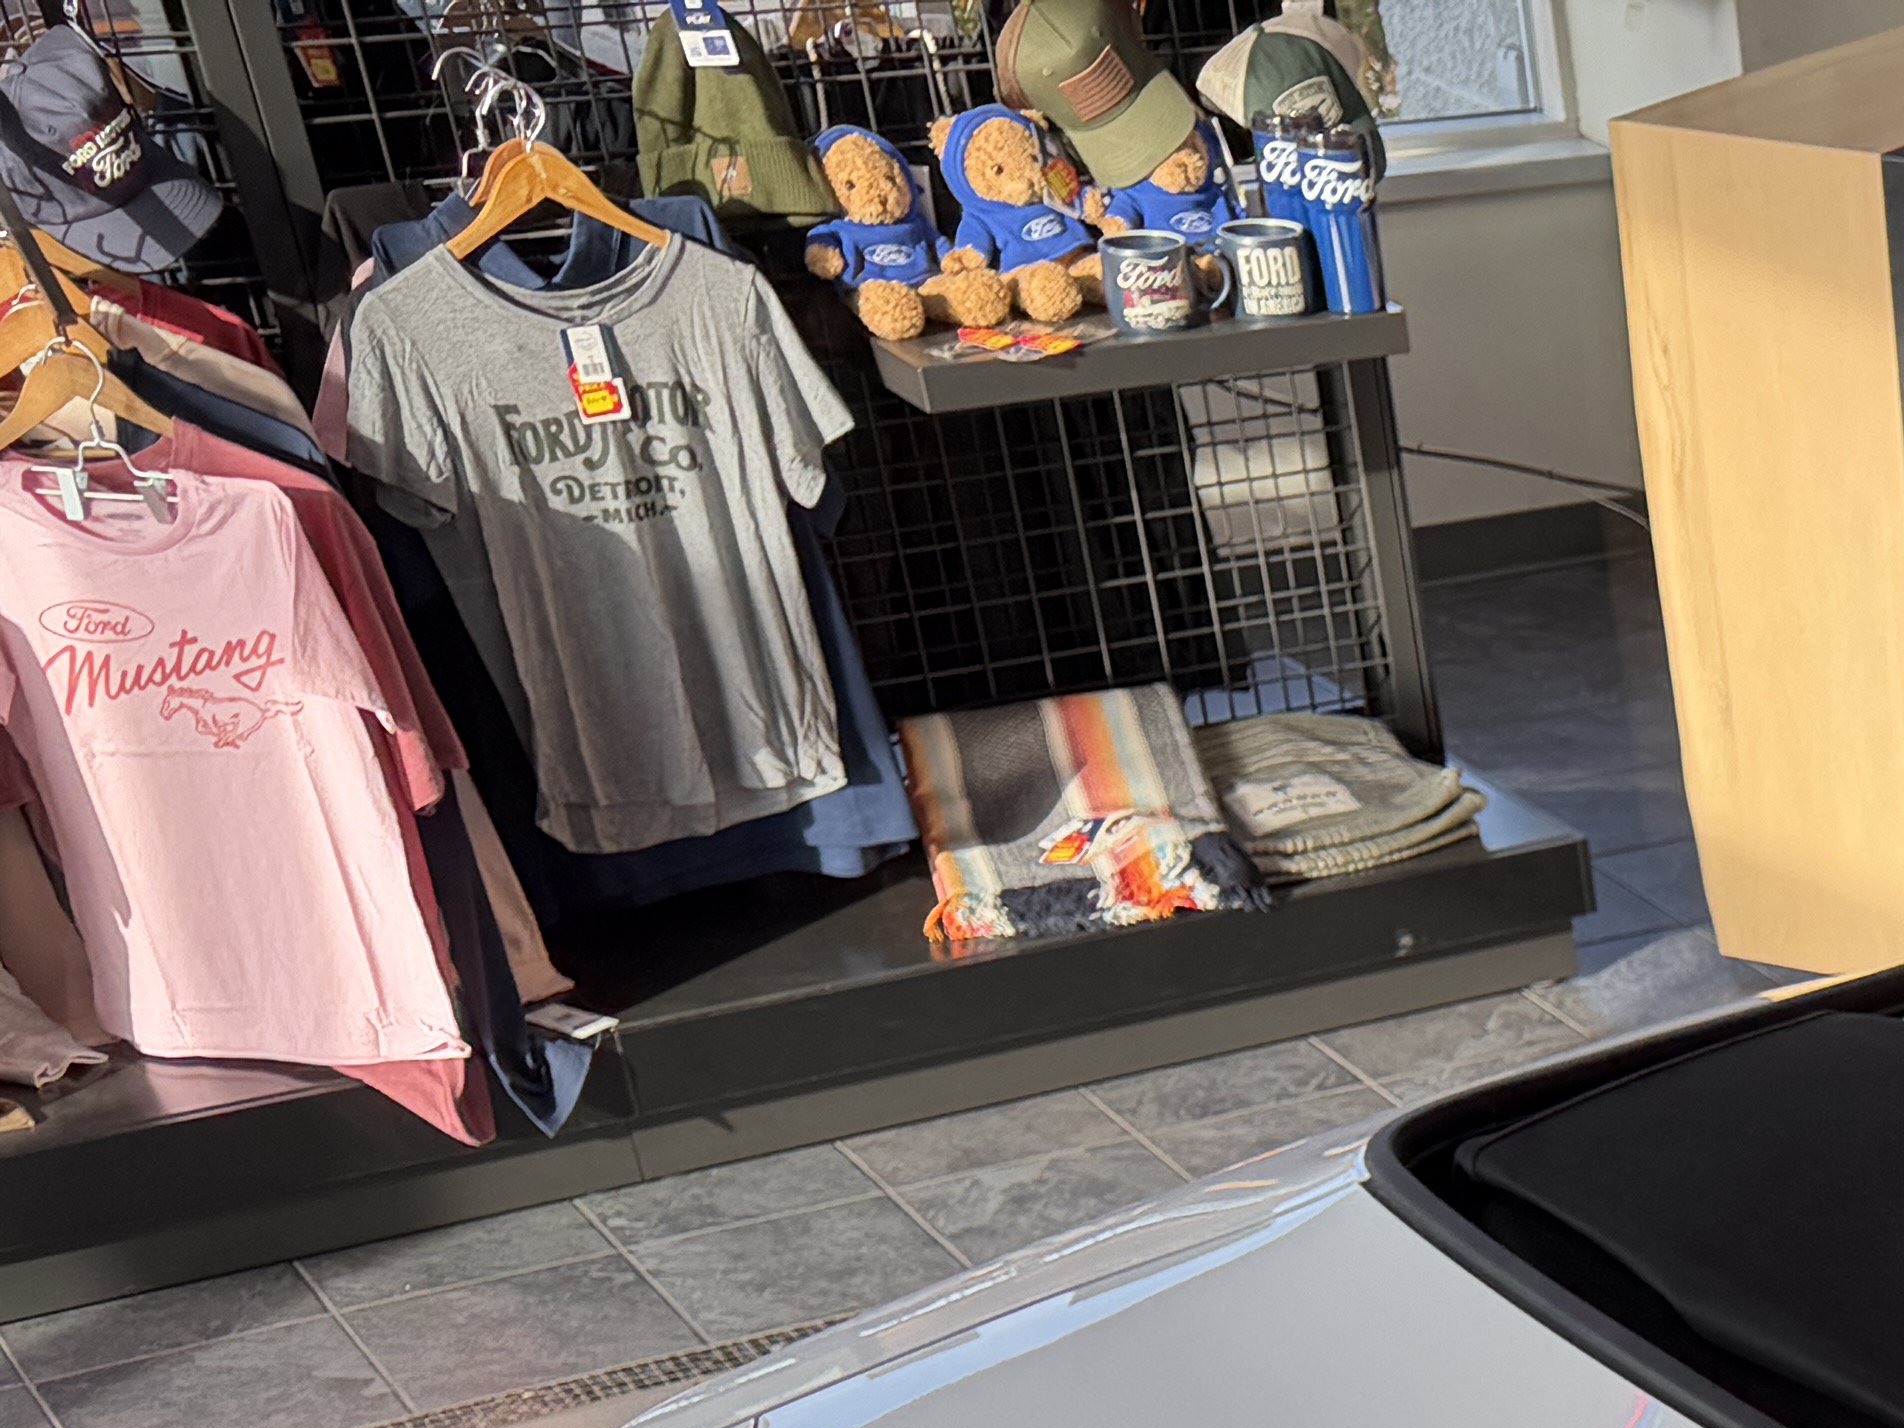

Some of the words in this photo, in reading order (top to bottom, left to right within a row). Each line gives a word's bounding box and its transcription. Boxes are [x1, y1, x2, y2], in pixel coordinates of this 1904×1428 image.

[62, 141, 97, 175] FORD
[92, 131, 141, 187] Ford
[1259, 140, 1300, 188] Fo
[1116, 256, 1184, 291] Ford
[1237, 246, 1302, 287] FORD
[492, 404, 594, 466] FORD
[550, 475, 685, 504] DETROIT,
[63, 605, 131, 636] Ford
[41, 629, 285, 716] Mustang
